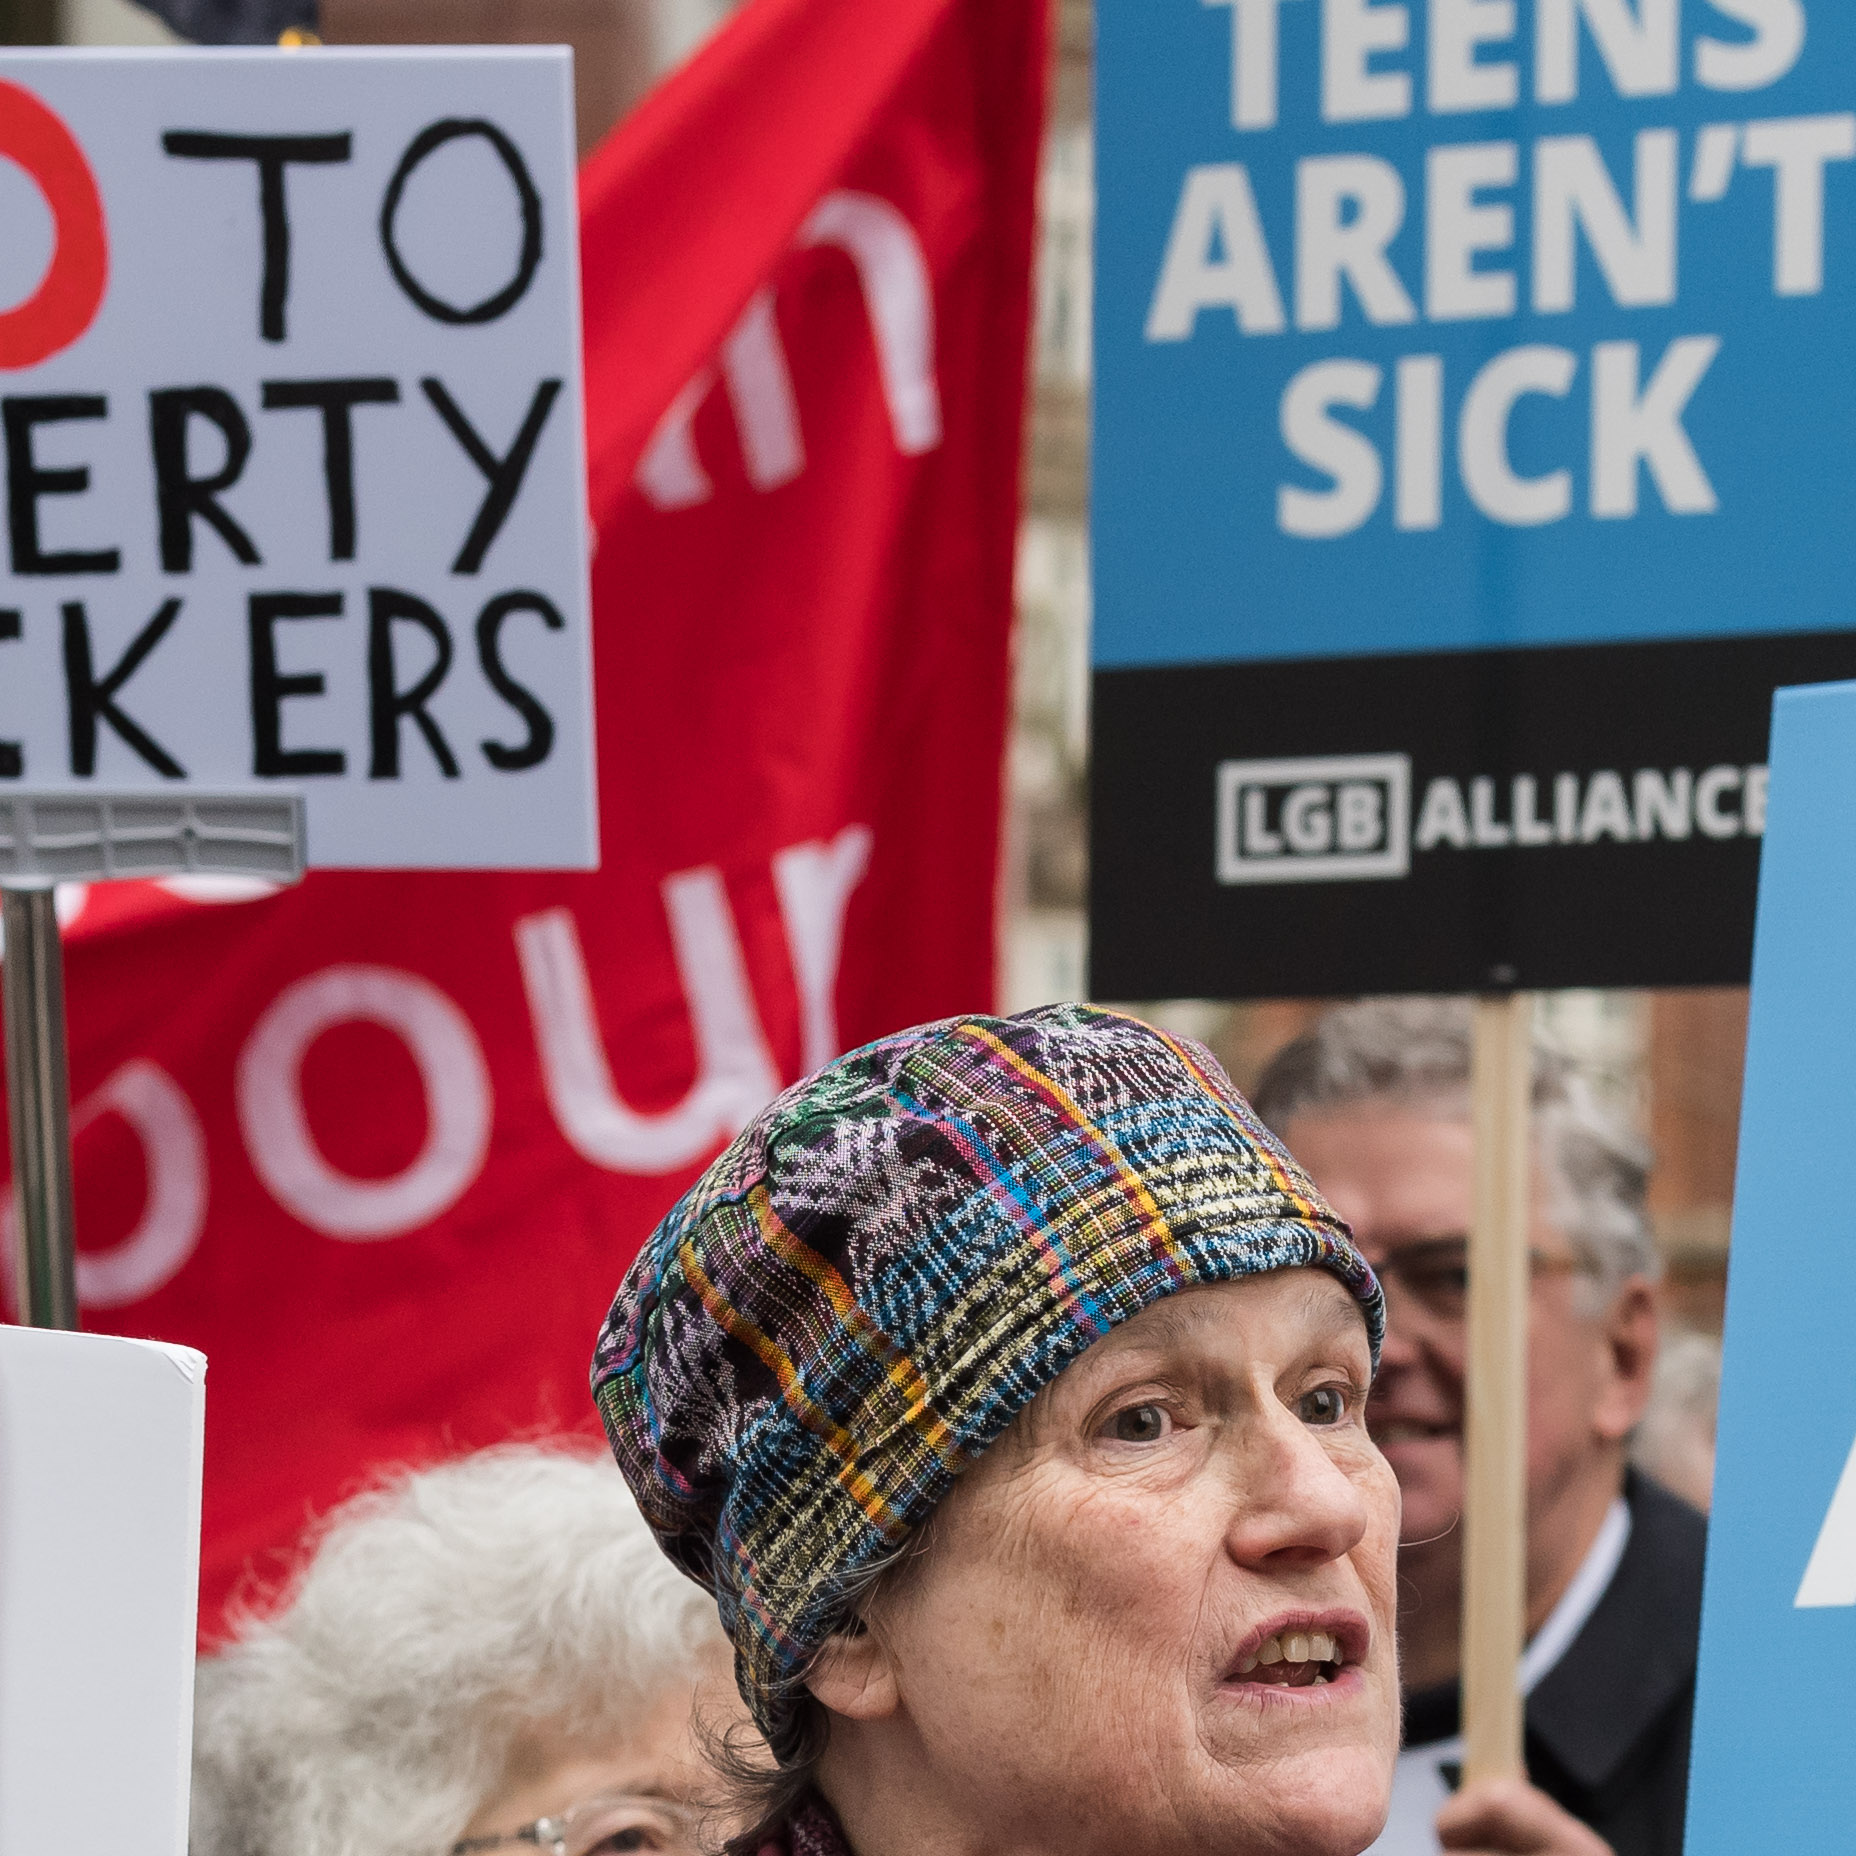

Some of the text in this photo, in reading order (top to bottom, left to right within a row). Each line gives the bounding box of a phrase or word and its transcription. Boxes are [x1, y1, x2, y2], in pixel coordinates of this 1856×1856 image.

[1202, 0, 1809, 130] TEENS
[162, 116, 544, 343] TO
[1276, 335, 1720, 540] SICK
[1245, 784, 1385, 855] LGB
